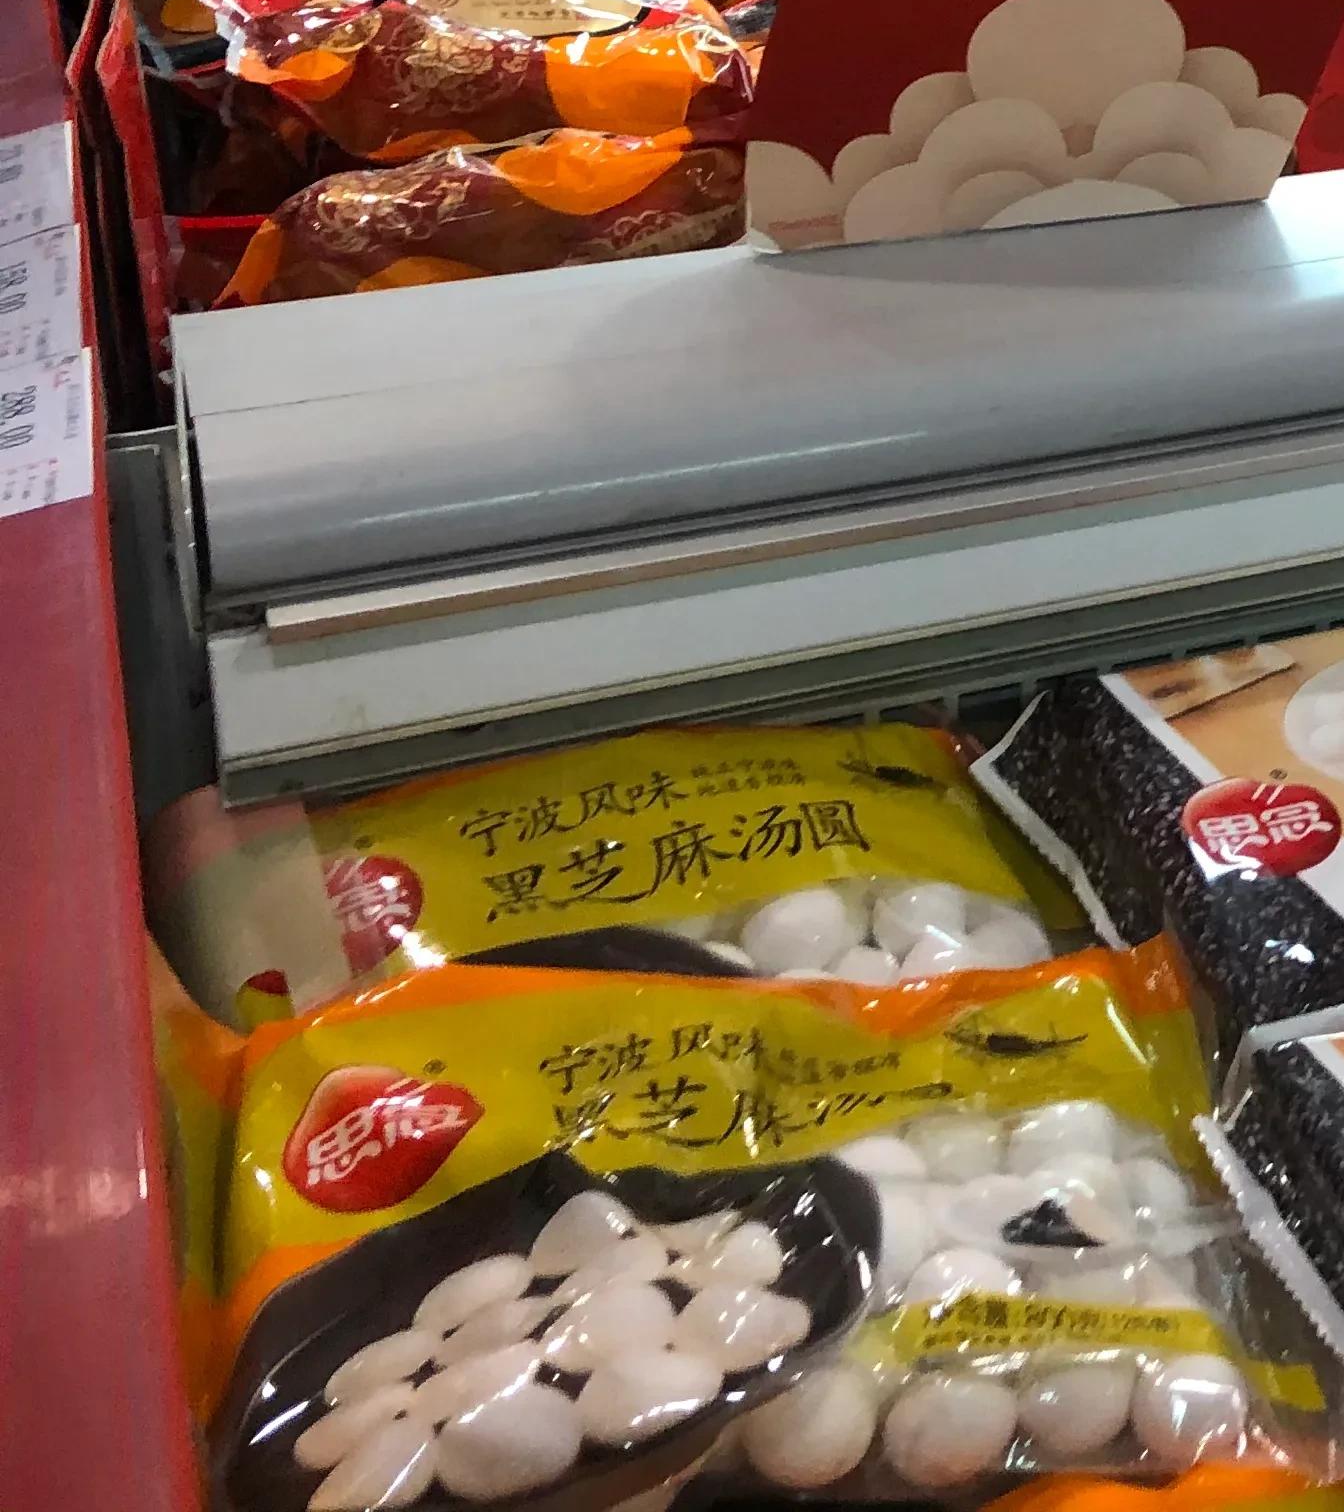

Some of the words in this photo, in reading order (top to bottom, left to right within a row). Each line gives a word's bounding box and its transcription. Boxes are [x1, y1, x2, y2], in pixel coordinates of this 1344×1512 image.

[459, 770, 689, 858] 宁波风味
[1197, 800, 1334, 854] 思念
[484, 800, 870, 924] 黑芝麻汤圆
[304, 1099, 469, 1186] 思念
